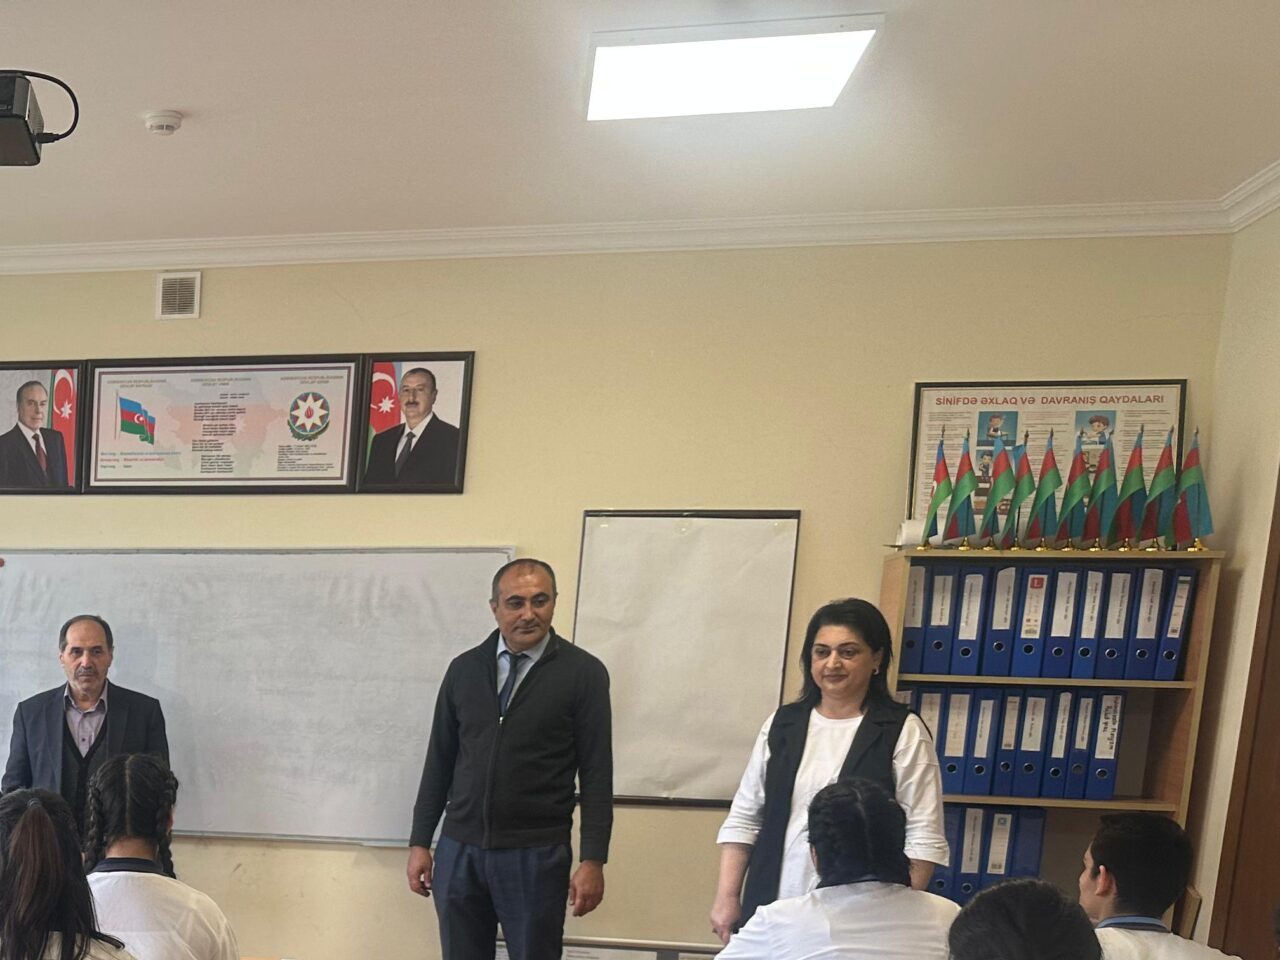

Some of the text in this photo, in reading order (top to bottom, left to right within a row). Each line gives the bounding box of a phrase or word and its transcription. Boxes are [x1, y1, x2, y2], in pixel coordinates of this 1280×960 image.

[935, 395, 1164, 407] SİNİFDƏ ƏXLAQ VƏ DAVRANIŞ QAYDALARI
